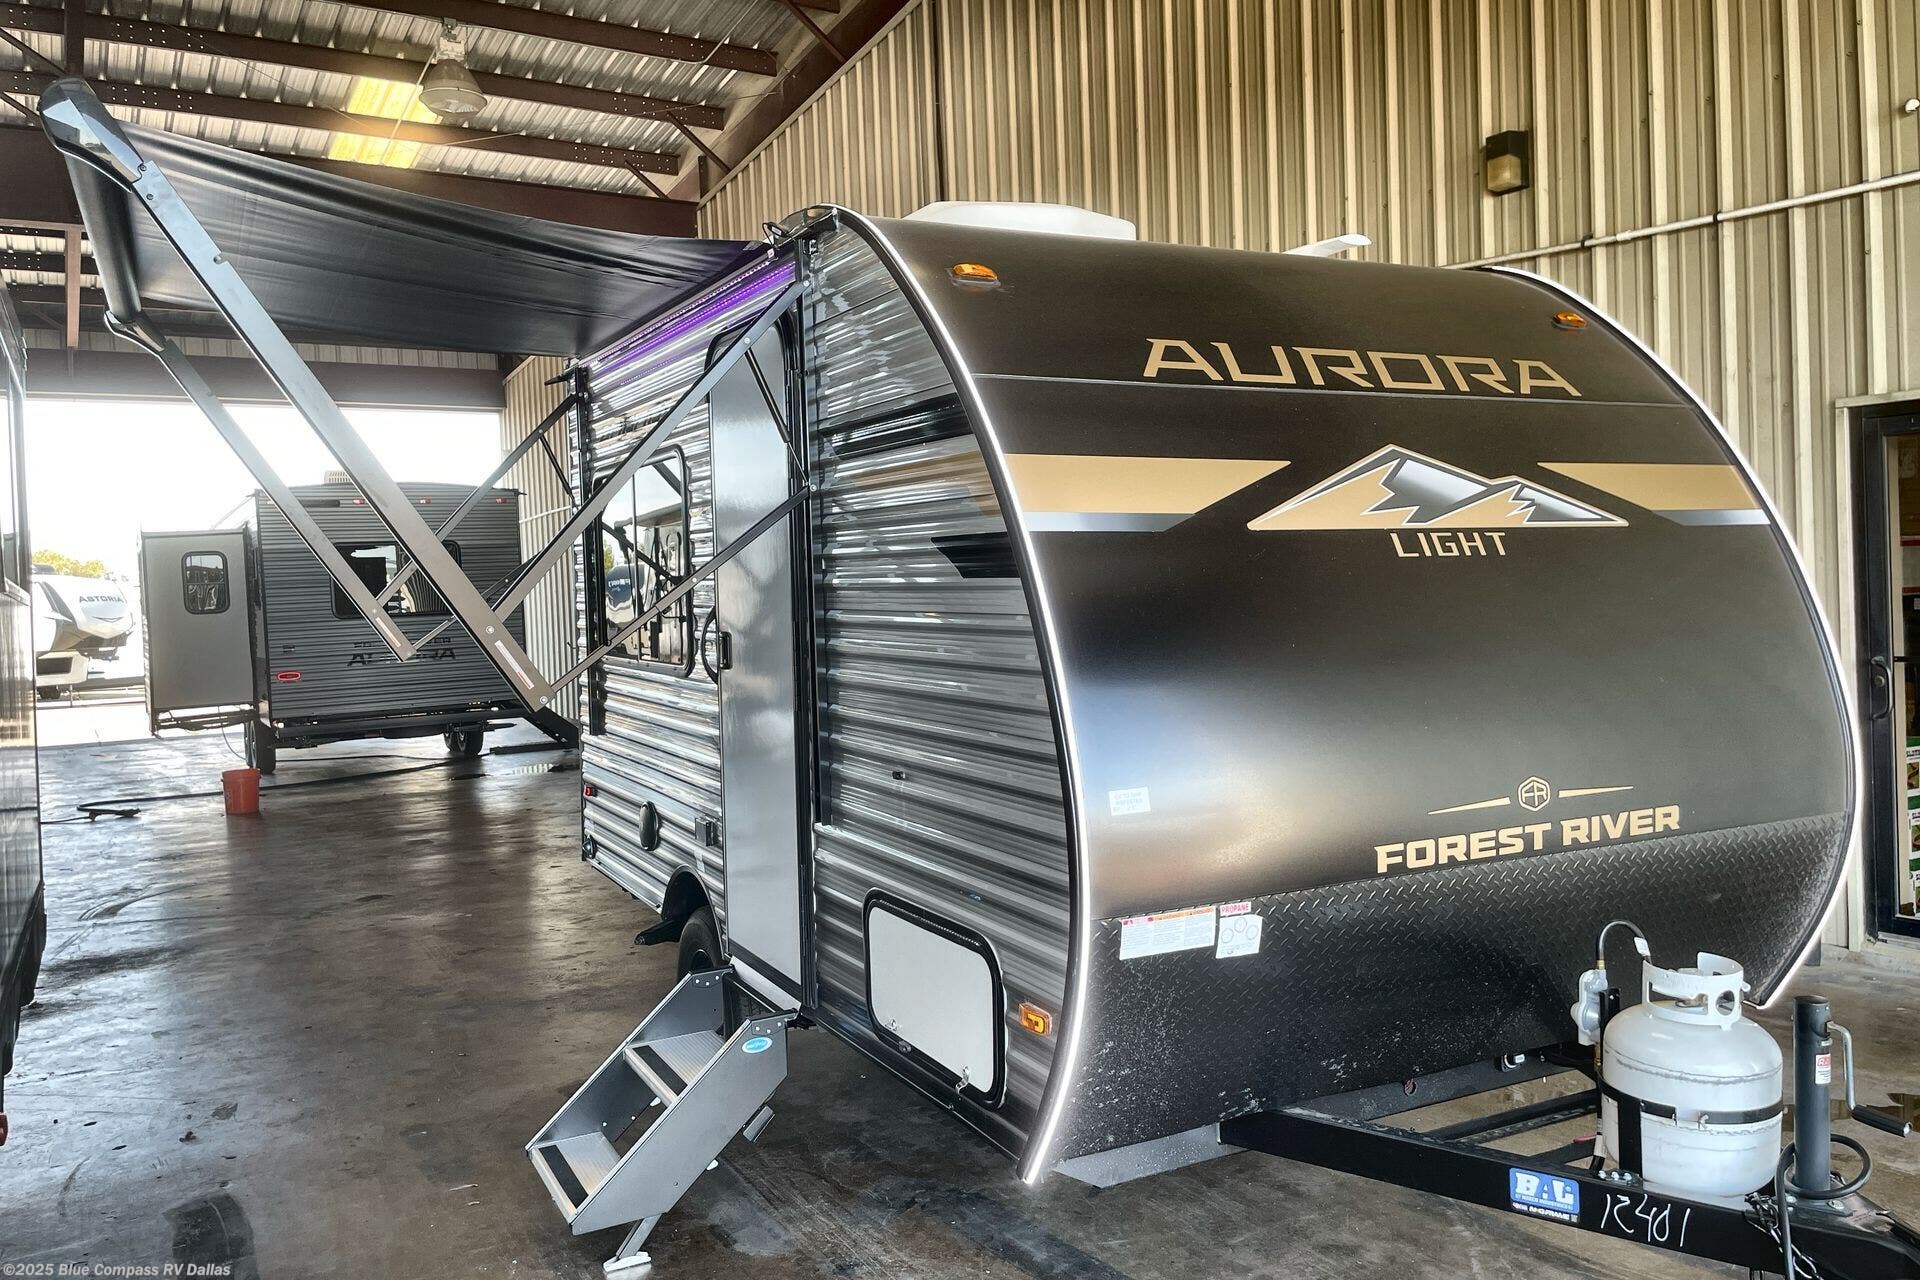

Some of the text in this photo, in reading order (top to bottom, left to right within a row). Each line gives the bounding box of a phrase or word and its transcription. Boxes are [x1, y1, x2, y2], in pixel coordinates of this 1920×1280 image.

[1143, 337, 1582, 397] AURORA
[1391, 531, 1506, 558] LIGHT
[79, 595, 124, 603] ASTORIA
[1375, 805, 1680, 874] FOREST RIVER
[1221, 903, 1249, 913] PROPANE
